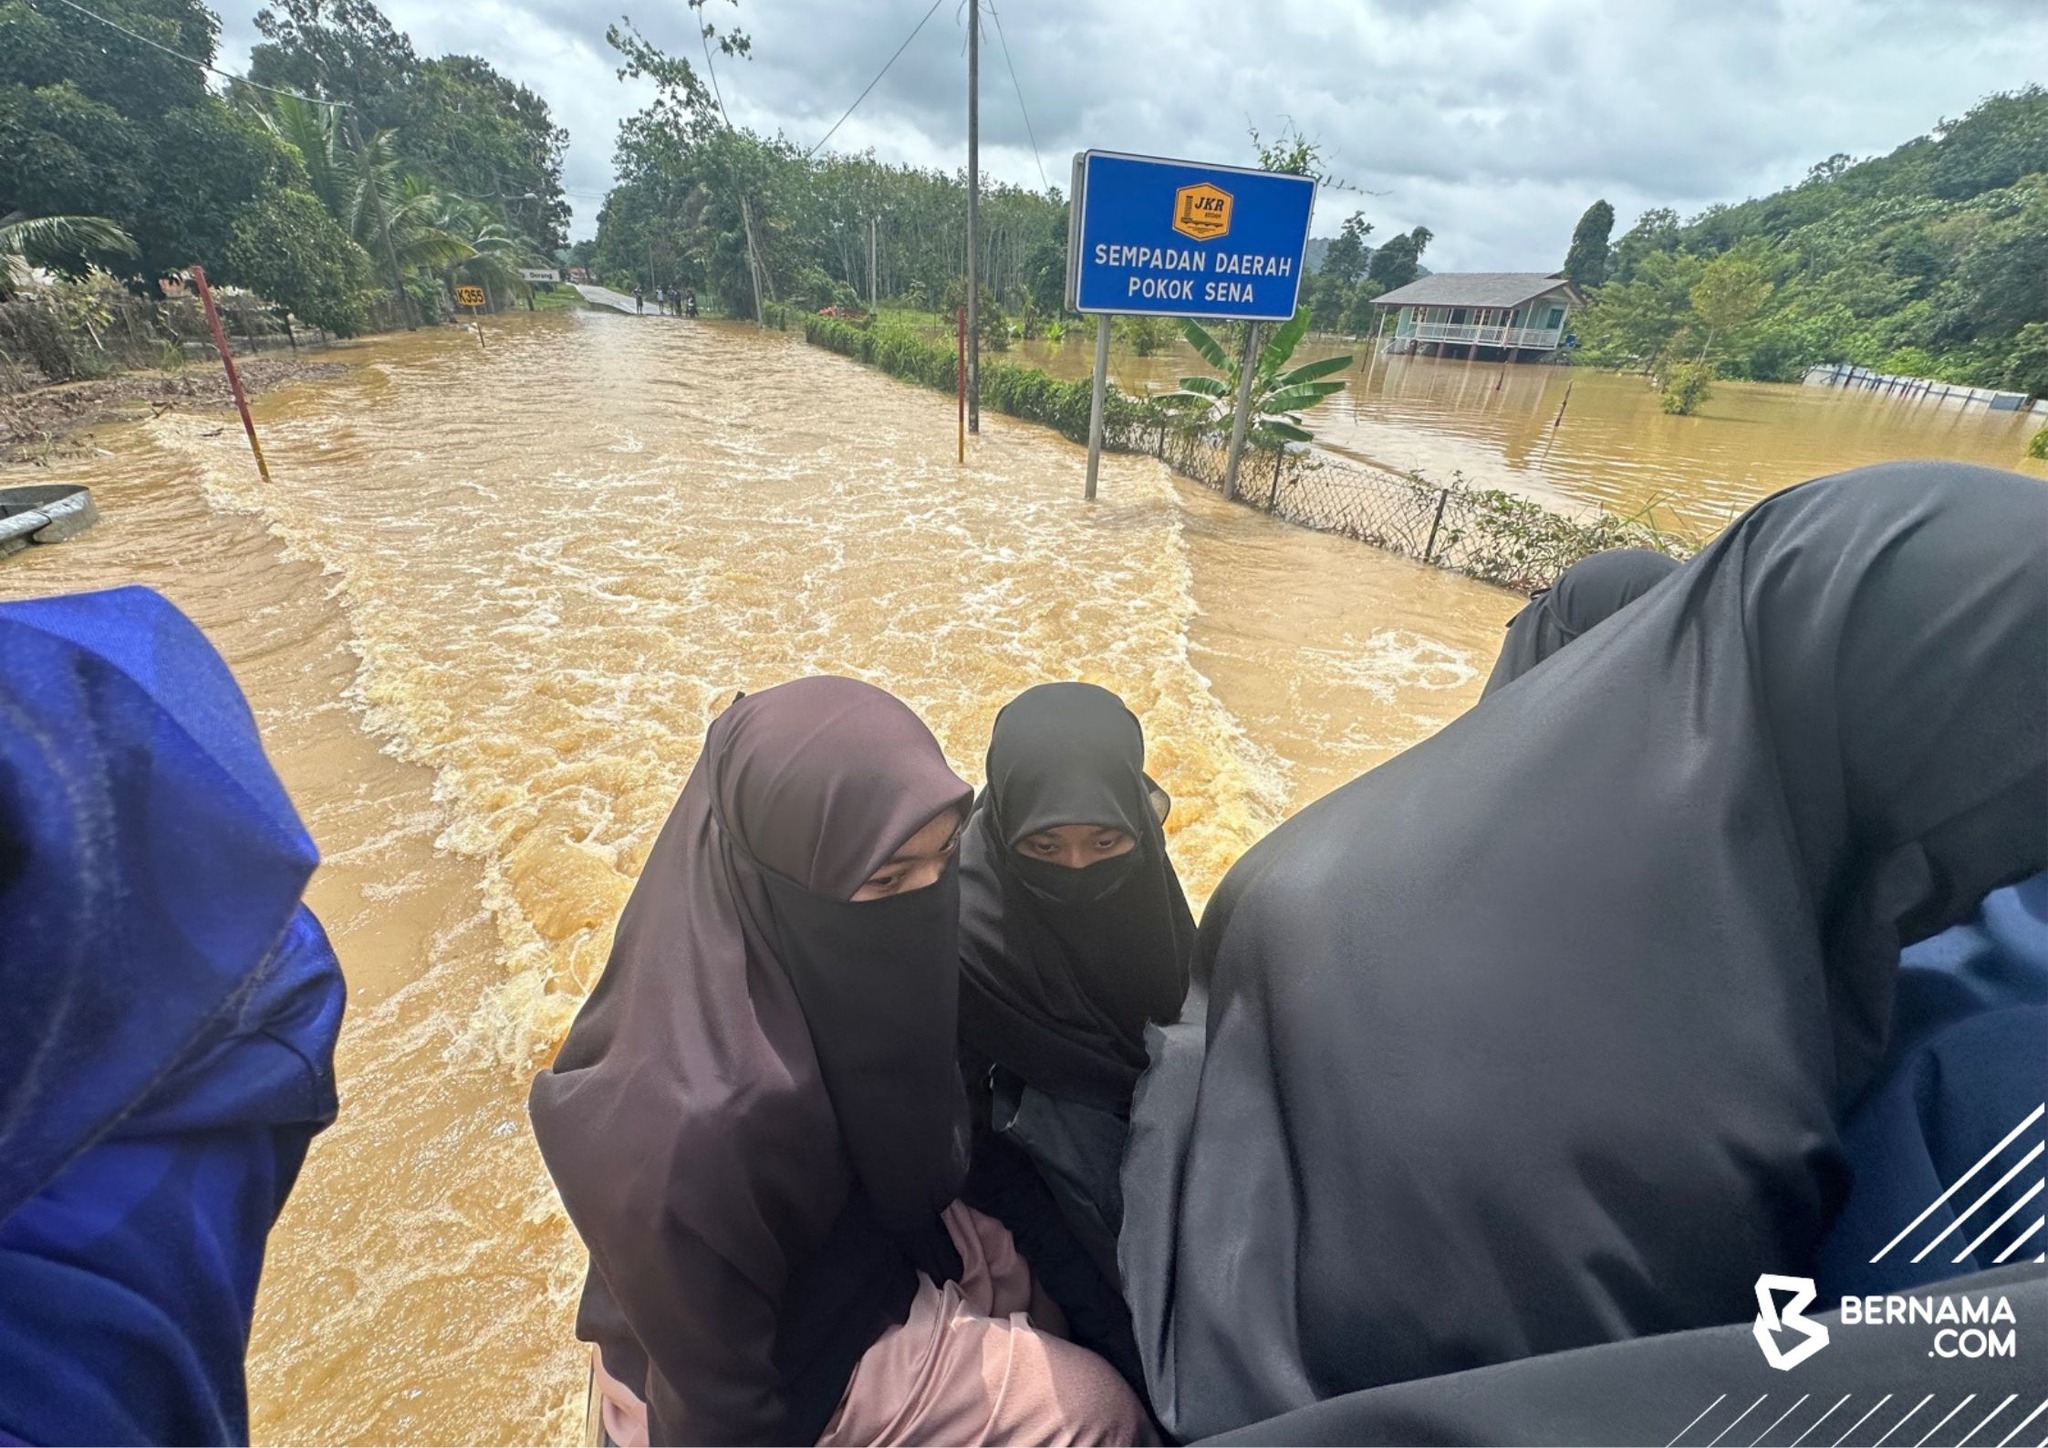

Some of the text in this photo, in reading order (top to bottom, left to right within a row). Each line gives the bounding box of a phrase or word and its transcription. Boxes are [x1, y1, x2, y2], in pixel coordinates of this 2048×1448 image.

[1195, 197, 1224, 212] JKR
[1095, 244, 1292, 277] SEMPADAN DAERAH
[457, 289, 484, 303] K355
[1128, 277, 1254, 303] POKOK SENA
